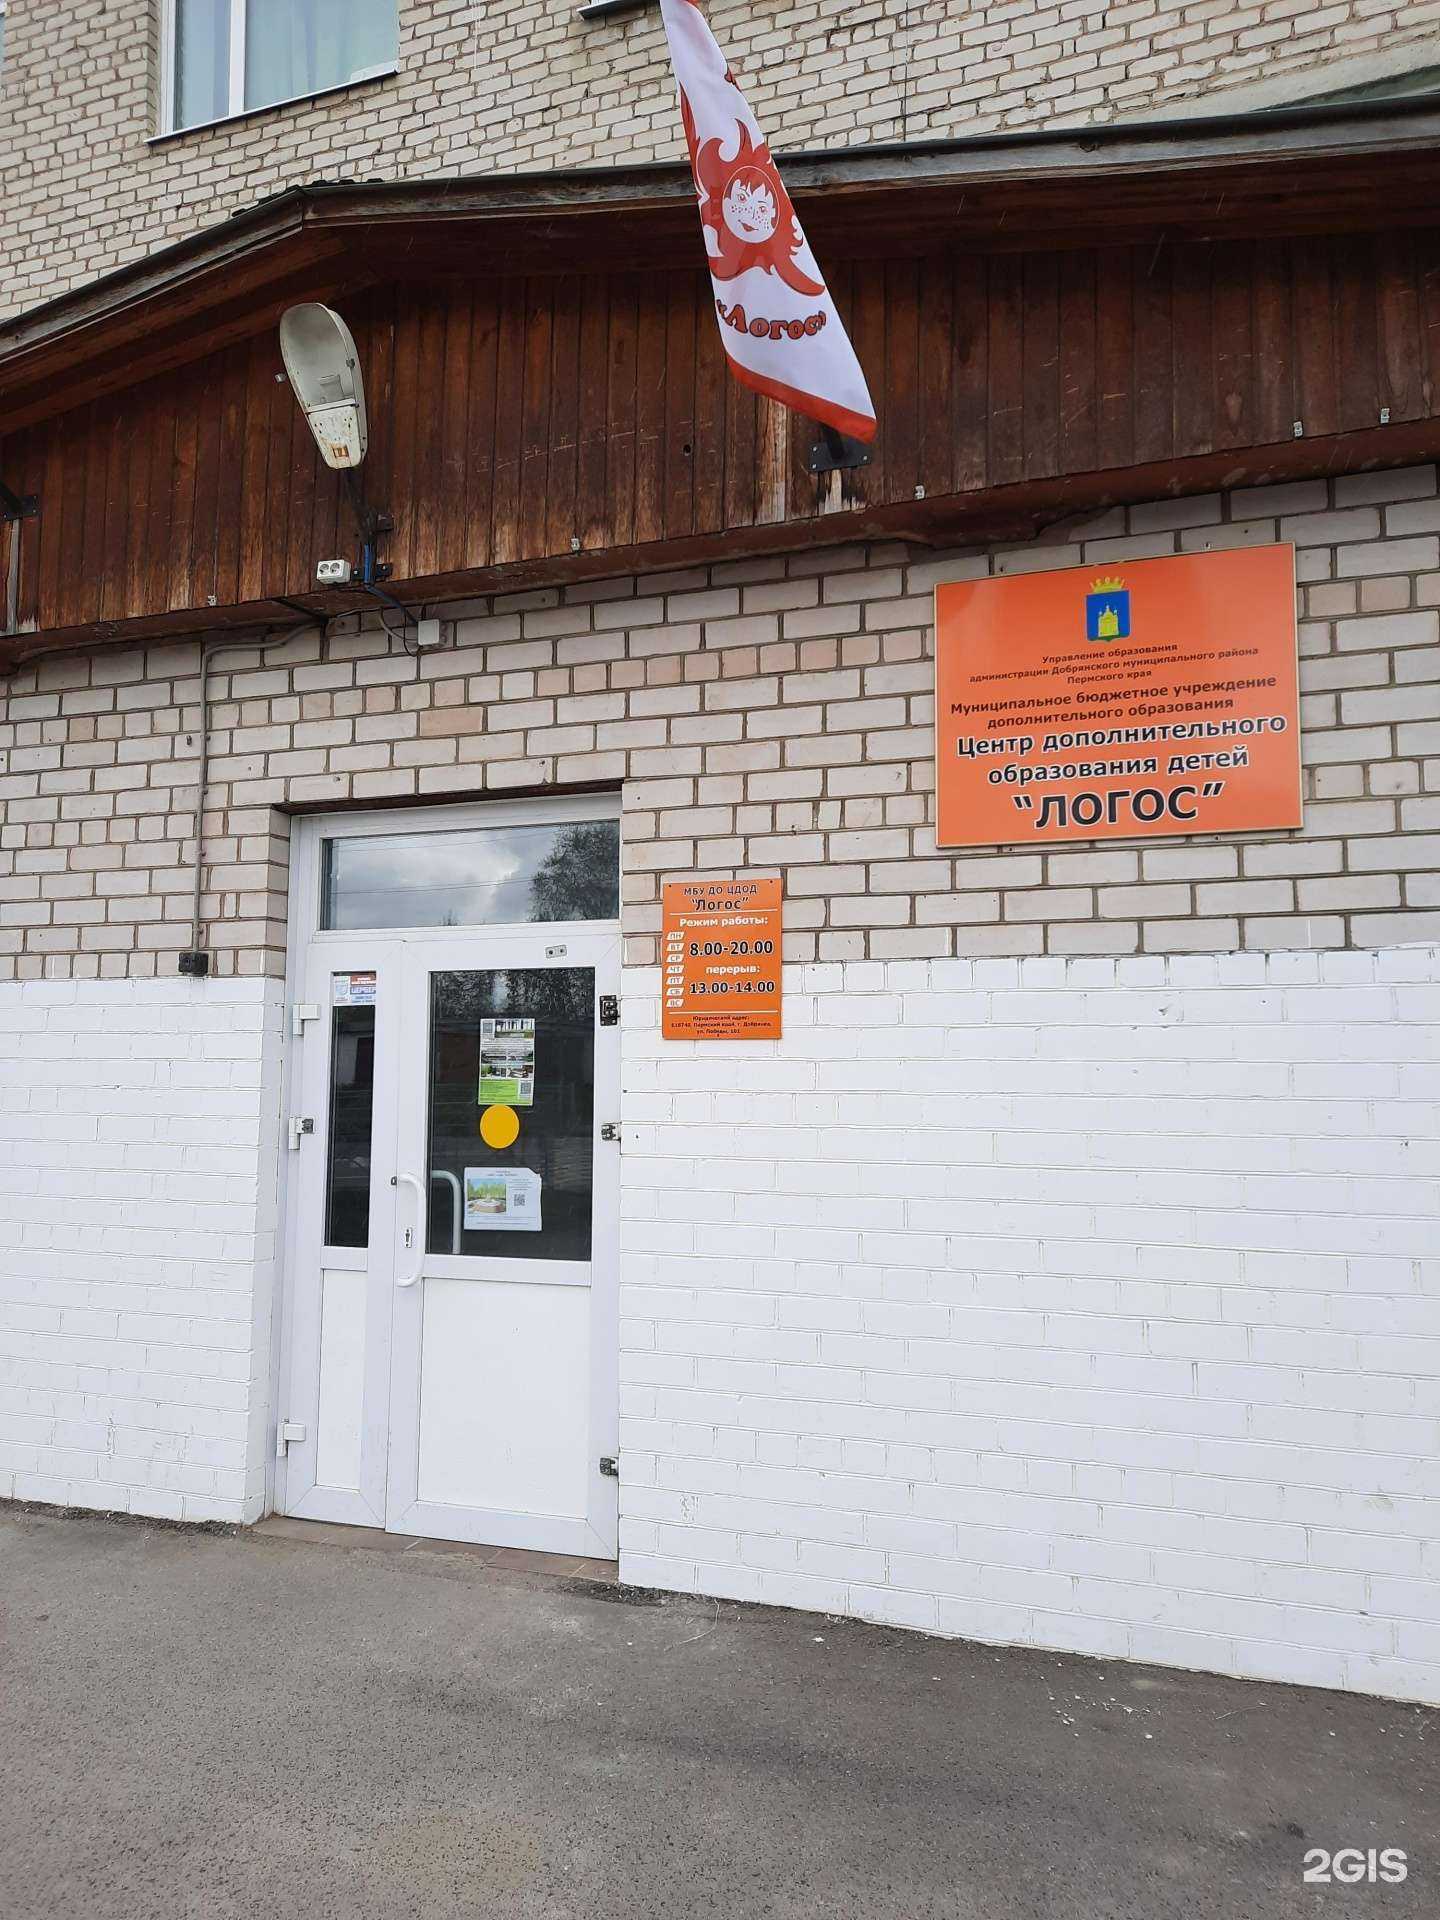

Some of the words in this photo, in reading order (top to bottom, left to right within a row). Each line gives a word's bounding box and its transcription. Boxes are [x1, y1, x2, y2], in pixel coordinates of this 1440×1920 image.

[1042, 651, 1105, 664] Управление
[1108, 644, 1178, 658] образования
[969, 669, 1049, 683] администрации
[1052, 660, 1119, 676] Добрянского
[1122, 653, 1215, 669] муниципального
[1218, 648, 1259, 660] района
[1067, 673, 1124, 685] Пермского
[1127, 670, 1152, 680] края
[951, 694, 1072, 716] Муниципальное
[1076, 686, 1169, 704] бюджетное
[1173, 676, 1277, 697] учреждение
[987, 707, 1124, 730] дополнительного
[1128, 698, 1234, 717] образования
[957, 736, 1034, 759] Центр
[1042, 716, 1287, 753] дополнительного
[988, 757, 1158, 787] образования
[1167, 746, 1249, 775] детей
[1013, 782, 1224, 829] "ЛОГОС"
[684, 887, 705, 896] МБУ
[709, 886, 723, 895] ДО
[727, 884, 757, 894] ЦДОД
[691, 897, 749, 911] "Логос"
[679, 918, 718, 927] Режим
[721, 915, 769, 927] работы:
[689, 940, 773, 956] 8.00-20.00
[705, 965, 761, 976] перерыв:
[690, 981, 775, 994] 13.00-14.00
